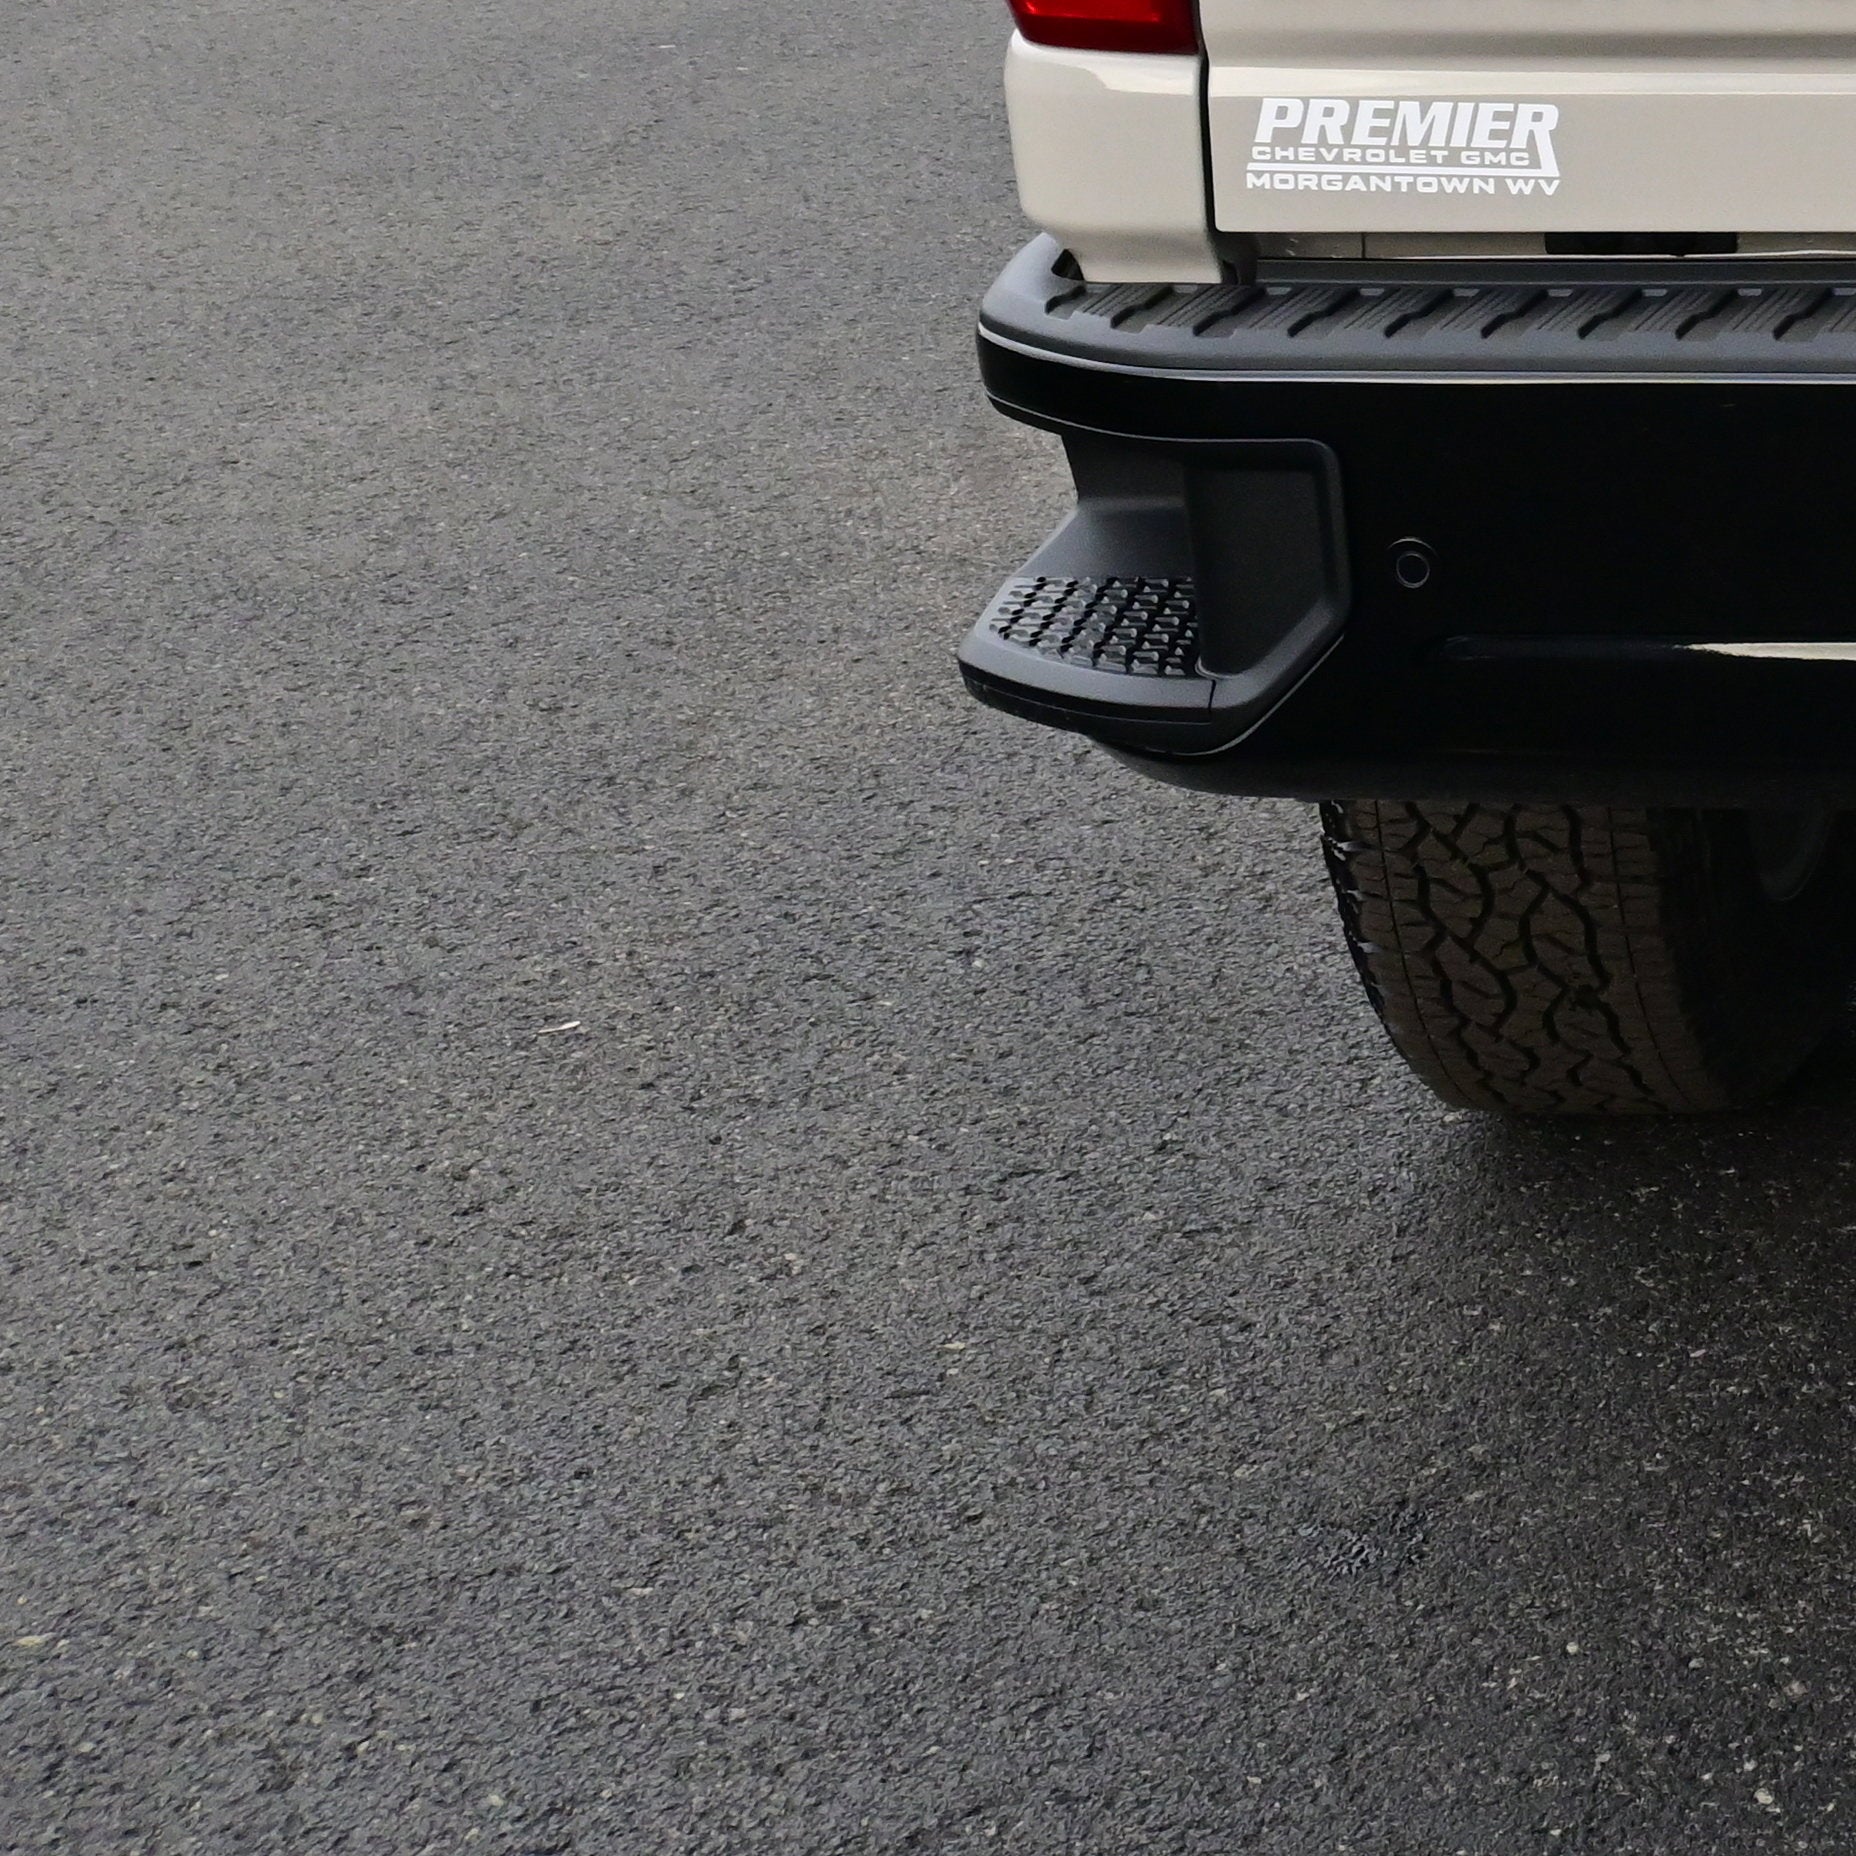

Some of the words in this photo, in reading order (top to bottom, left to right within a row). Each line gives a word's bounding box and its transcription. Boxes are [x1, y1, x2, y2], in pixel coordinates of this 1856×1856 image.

[1254, 96, 1560, 177] PREMIER
[1250, 145, 1448, 166] CHEVROLET
[1460, 149, 1530, 167] GMC
[1246, 172, 1495, 196] MORGANTOWN
[1503, 178, 1561, 197] WV
